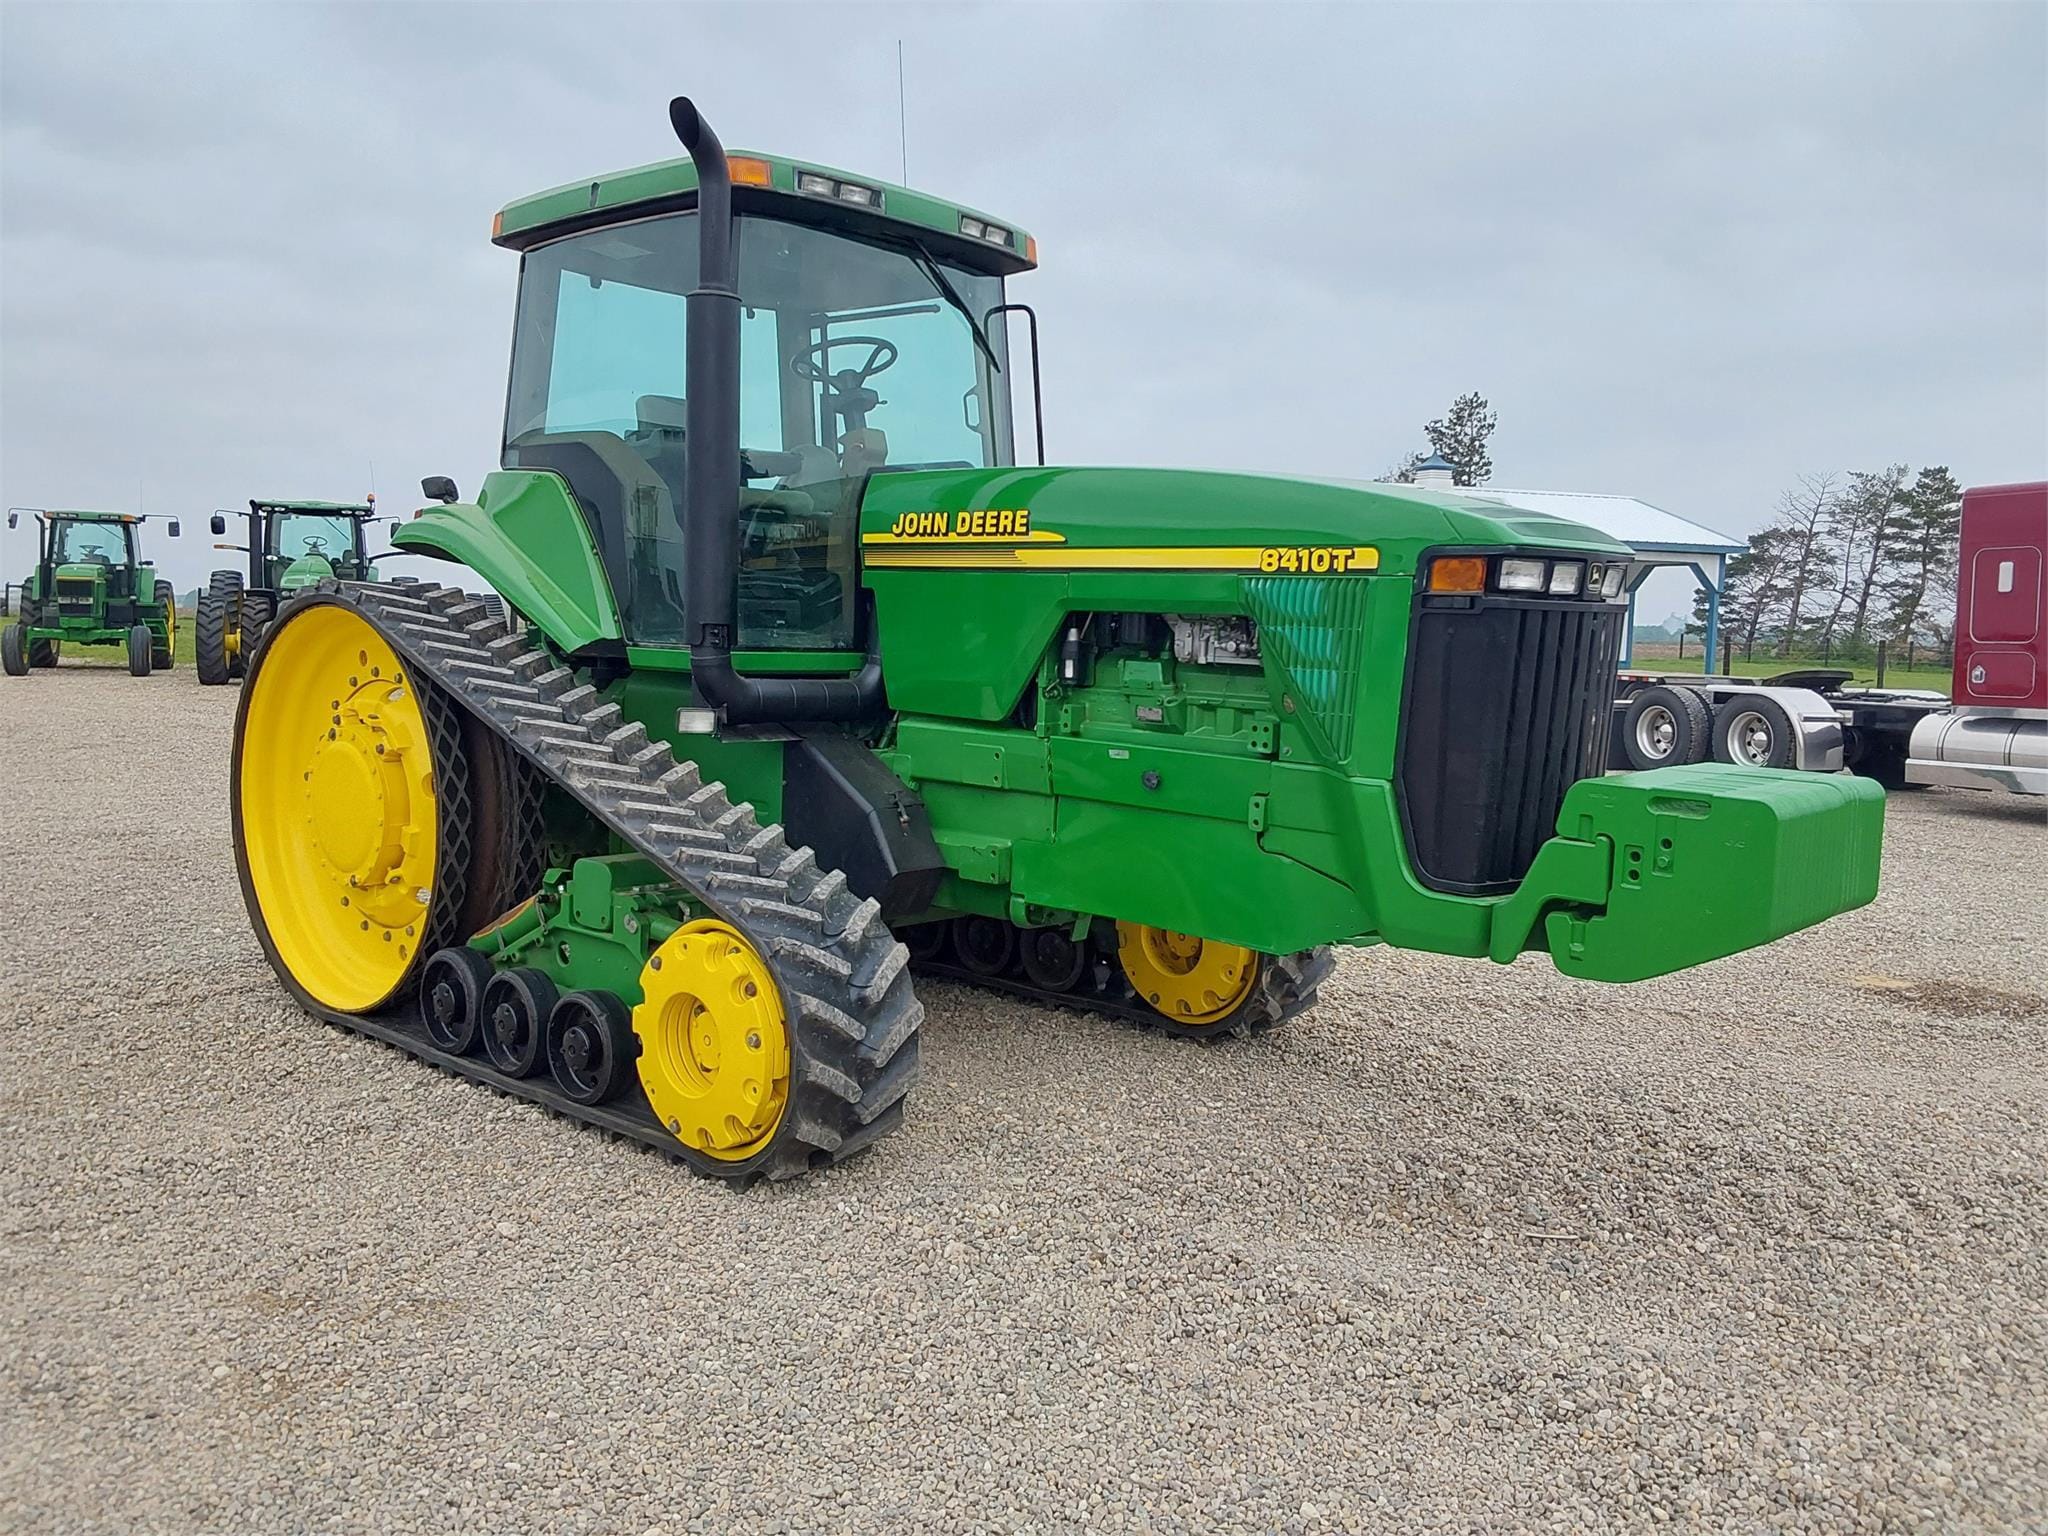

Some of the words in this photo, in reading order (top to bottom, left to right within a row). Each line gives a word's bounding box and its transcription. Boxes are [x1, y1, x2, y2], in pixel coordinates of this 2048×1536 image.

[891, 512, 949, 537] JOHN
[955, 510, 1030, 536] DEERE
[1260, 548, 1353, 573] 8410T
